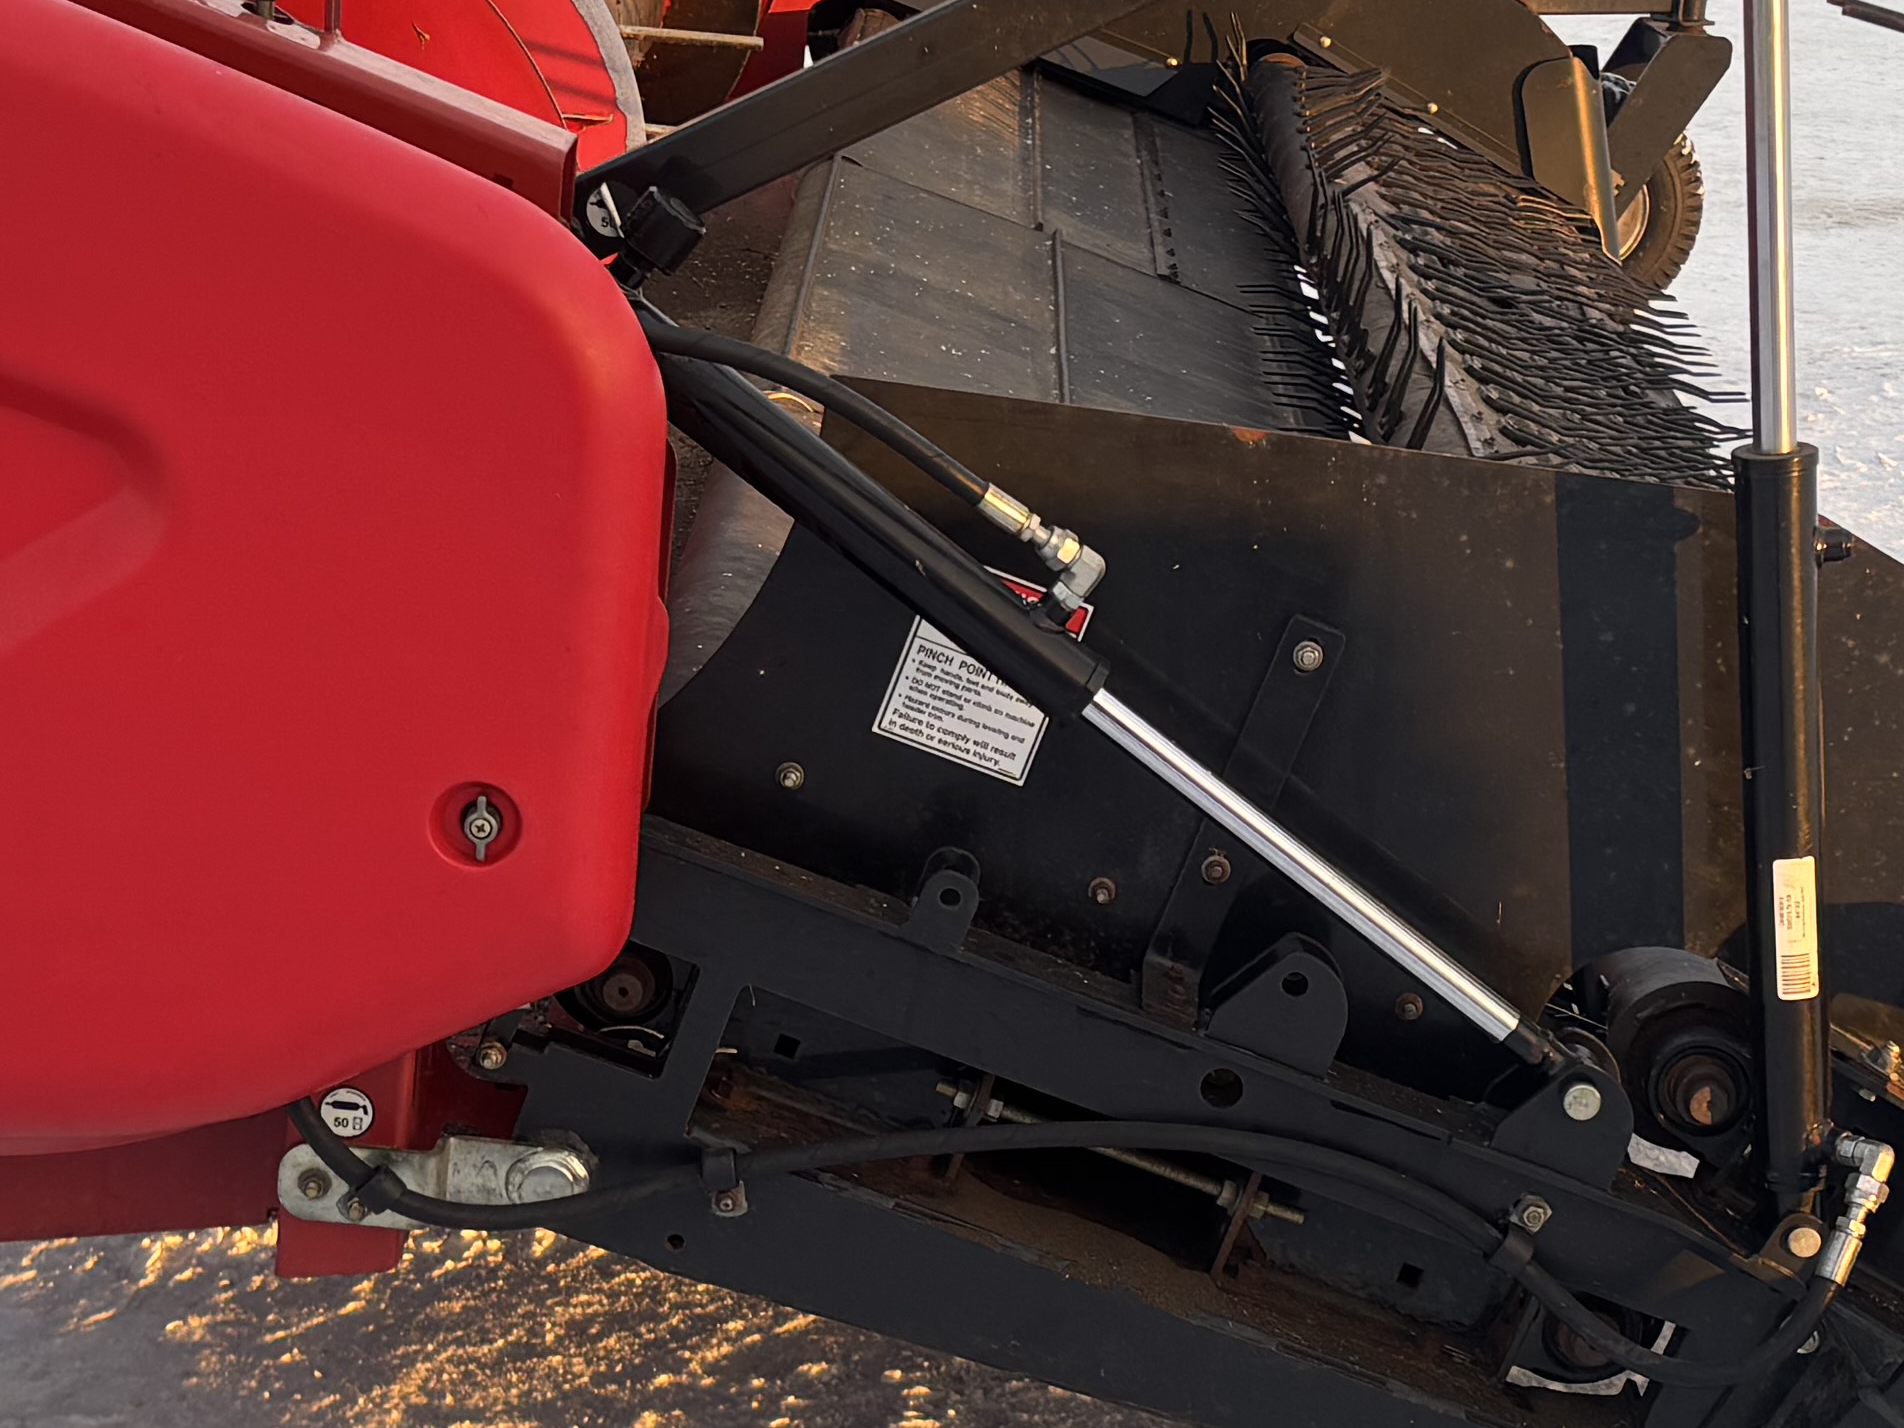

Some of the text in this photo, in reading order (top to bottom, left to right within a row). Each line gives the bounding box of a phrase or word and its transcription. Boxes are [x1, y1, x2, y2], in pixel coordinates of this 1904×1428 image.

[916, 644, 955, 666] PINCH
[892, 707, 925, 726] Failure
[935, 726, 971, 745] comply
[972, 738, 990, 750] will
[989, 745, 1017, 761] result
[899, 722, 925, 738] death
[937, 737, 971, 755] serious
[333, 1116, 349, 1128] 50
